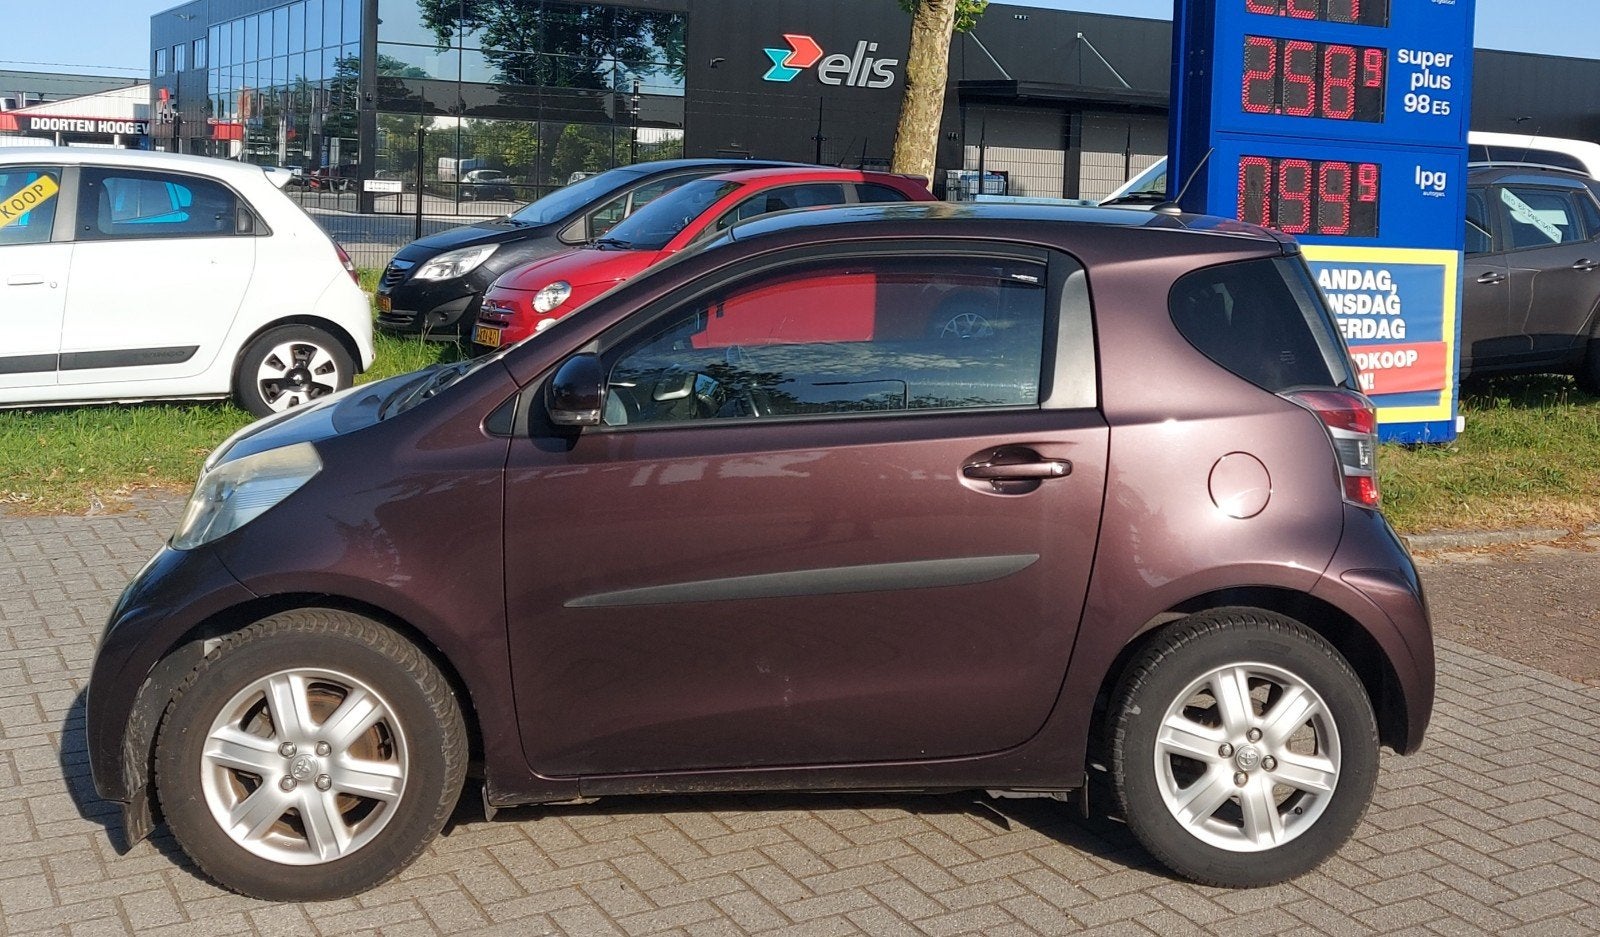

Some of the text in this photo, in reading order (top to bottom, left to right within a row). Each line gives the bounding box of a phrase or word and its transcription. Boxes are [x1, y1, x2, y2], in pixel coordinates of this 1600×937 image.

[818, 40, 899, 89] elis
[1397, 48, 1453, 69] super
[1411, 69, 1451, 90] plus
[1404, 93, 1450, 115] 98 E5
[30, 117, 95, 133] DOORTEN
[1415, 165, 1447, 191] lpg
[0, 184, 44, 219] KOOP
[1326, 294, 1401, 315] NSDAG
[1353, 349, 1418, 370] DKOOP
